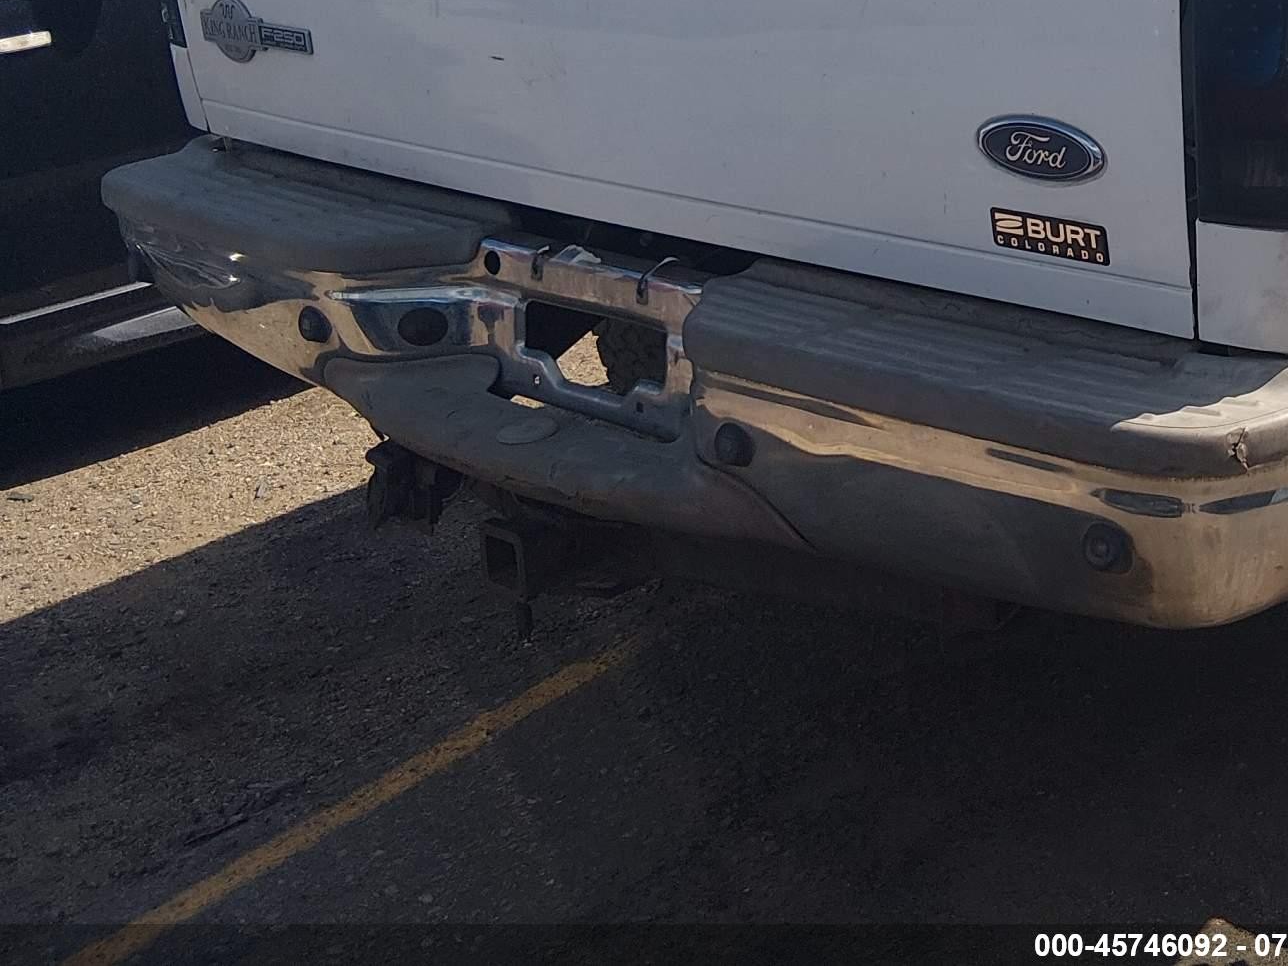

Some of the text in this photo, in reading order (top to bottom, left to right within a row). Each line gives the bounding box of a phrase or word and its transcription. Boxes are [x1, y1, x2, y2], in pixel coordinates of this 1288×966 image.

[201, 17, 257, 44] KING RANCH
[1005, 130, 1067, 169] Ford
[1026, 217, 1101, 249] BURT
[997, 235, 1104, 262] COLORADO
